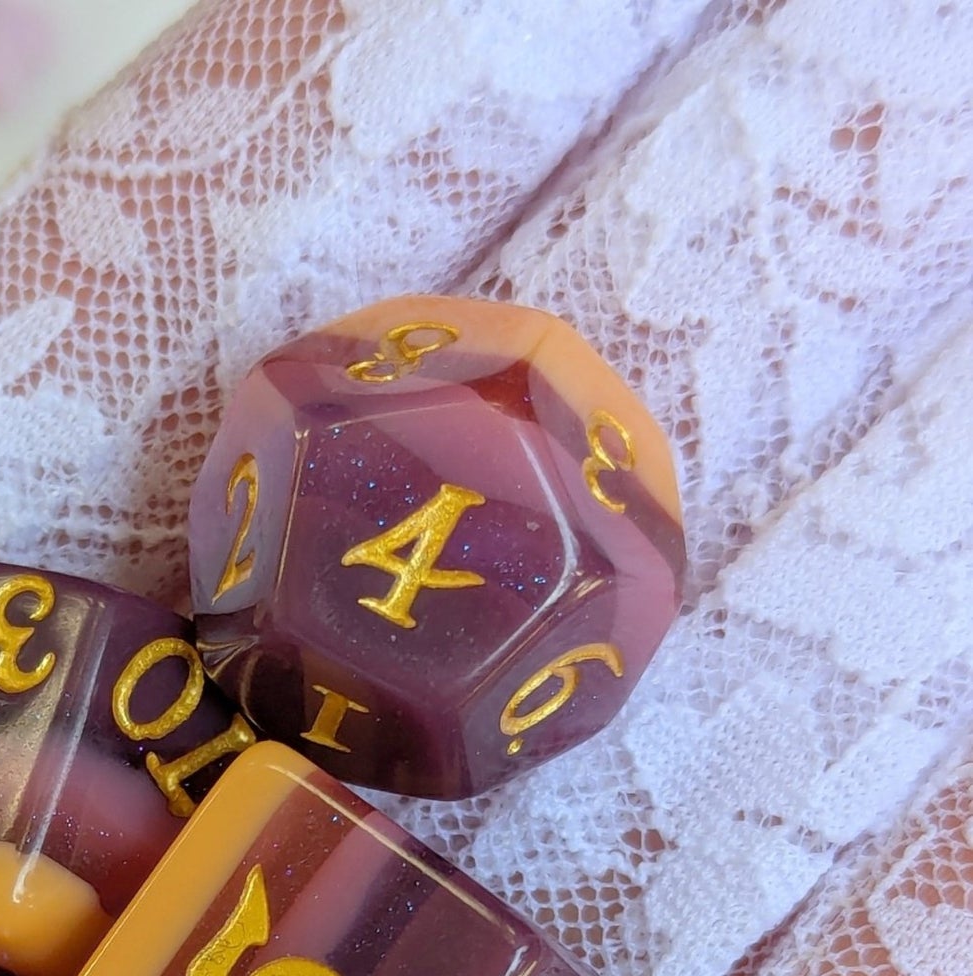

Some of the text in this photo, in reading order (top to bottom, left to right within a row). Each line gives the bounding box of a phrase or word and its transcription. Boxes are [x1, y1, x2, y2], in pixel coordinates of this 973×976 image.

[346, 321, 459, 383] 8
[583, 410, 635, 513] 3
[211, 452, 258, 605] 2
[341, 484, 486, 629] 4
[112, 637, 258, 818] 10
[300, 685, 370, 753] 1
